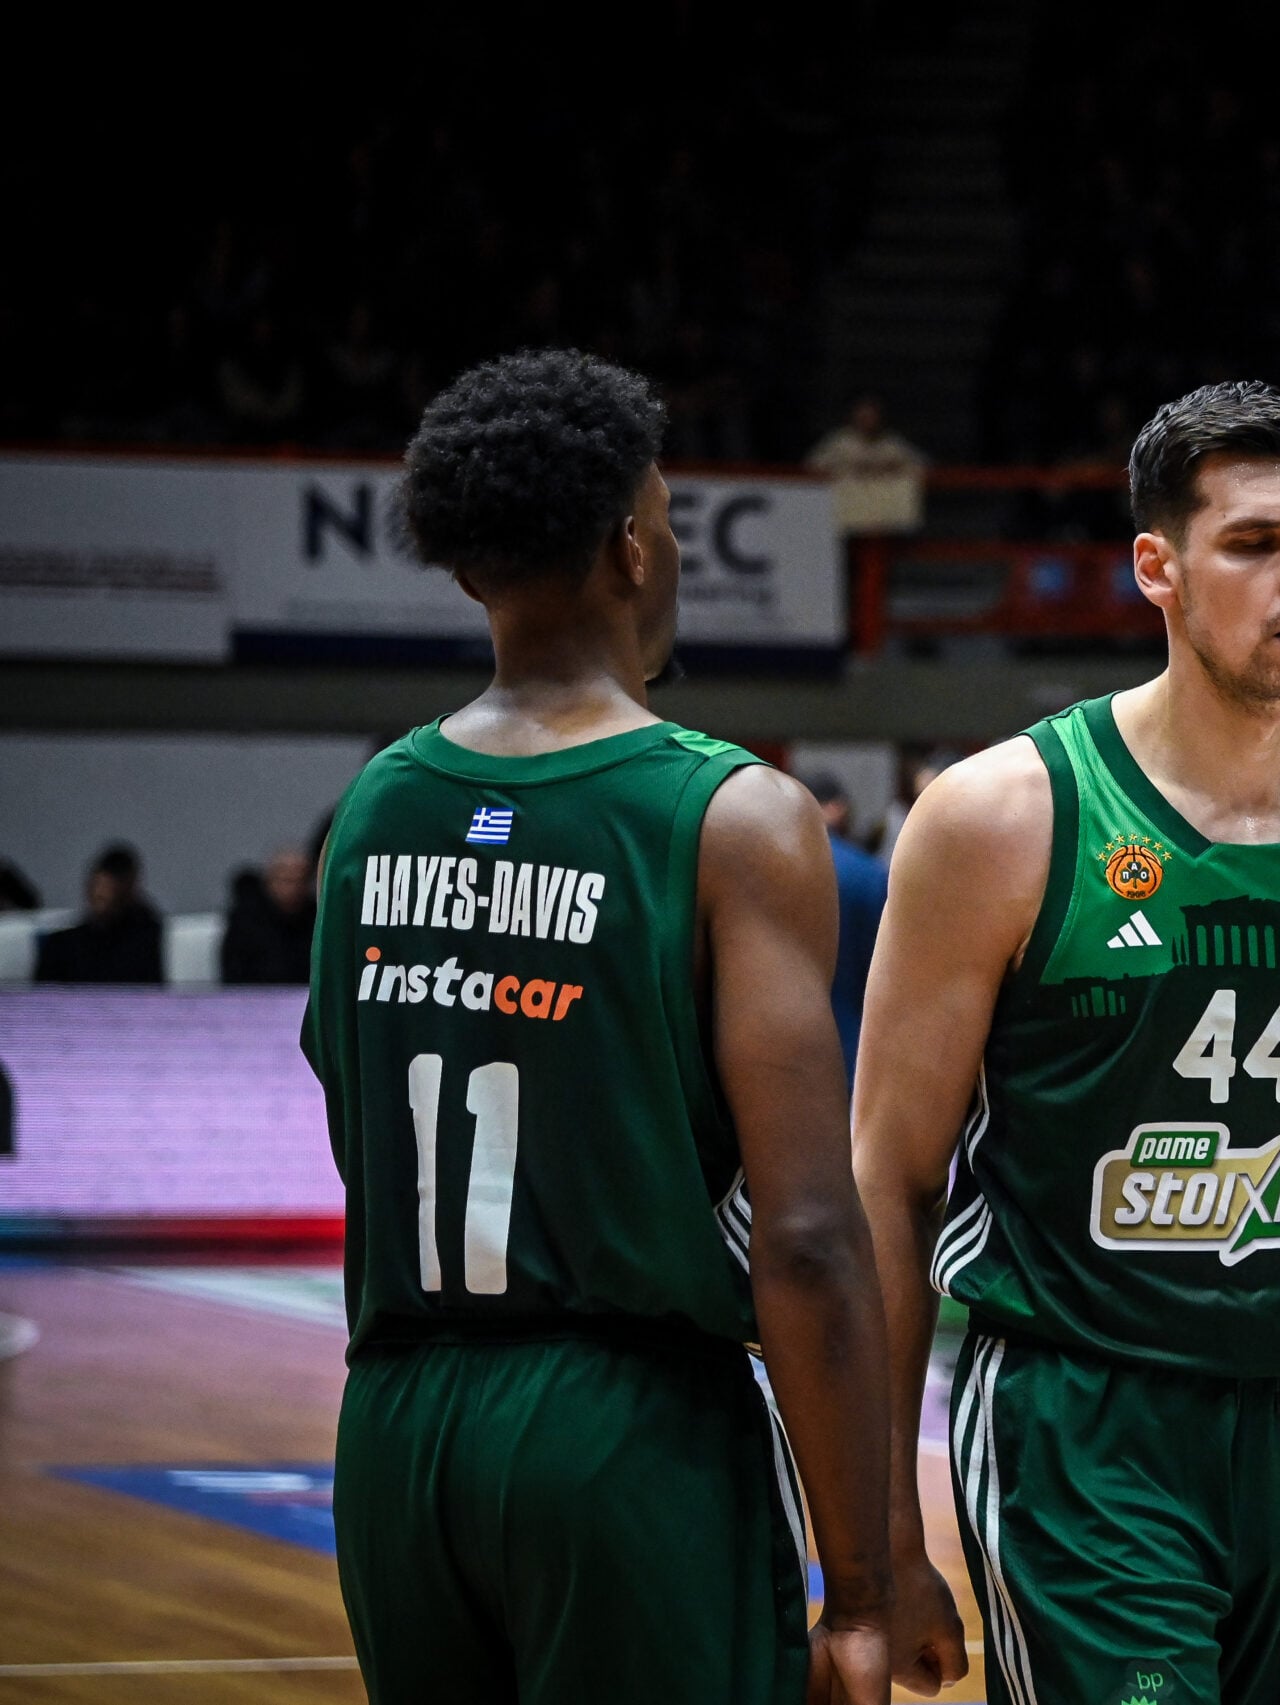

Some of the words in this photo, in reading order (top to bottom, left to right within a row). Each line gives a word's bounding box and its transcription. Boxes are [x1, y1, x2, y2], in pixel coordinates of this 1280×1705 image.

[361, 855, 605, 944] HAYES-DAVIS
[357, 946, 584, 1021] instacar
[408, 1053, 520, 1294] 11
[1138, 1136, 1211, 1163] pame
[1136, 1671, 1164, 1692] bp
